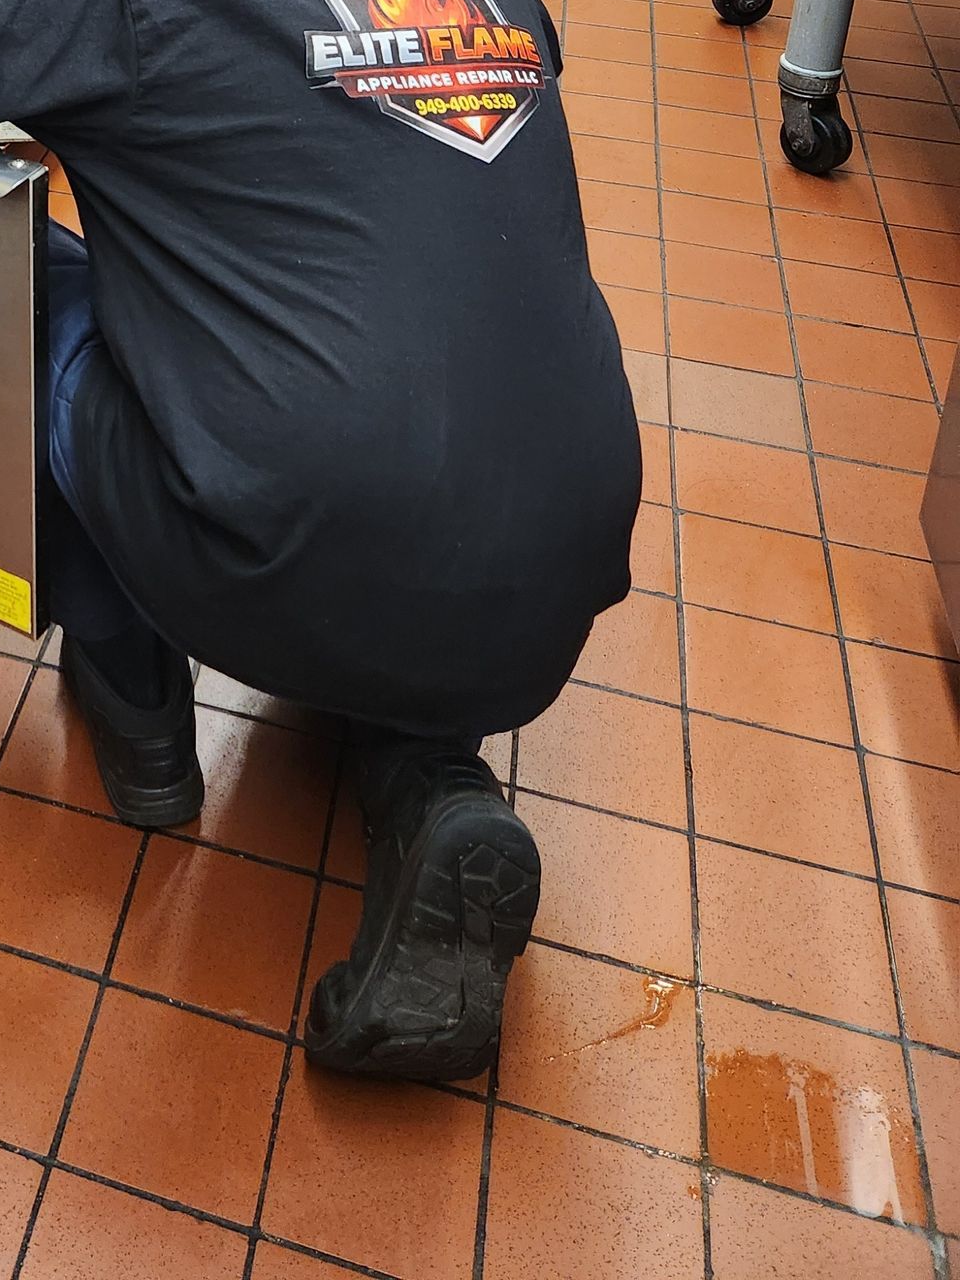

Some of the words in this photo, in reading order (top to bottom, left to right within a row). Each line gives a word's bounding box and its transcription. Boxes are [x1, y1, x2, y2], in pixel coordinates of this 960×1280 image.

[311, 30, 424, 70] ELITE
[427, 27, 540, 63] FLAME
[357, 73, 453, 93] APPLIANCE
[458, 70, 514, 86] REPAIR
[517, 70, 539, 84] LLC
[415, 93, 517, 116] 949-400-6339
